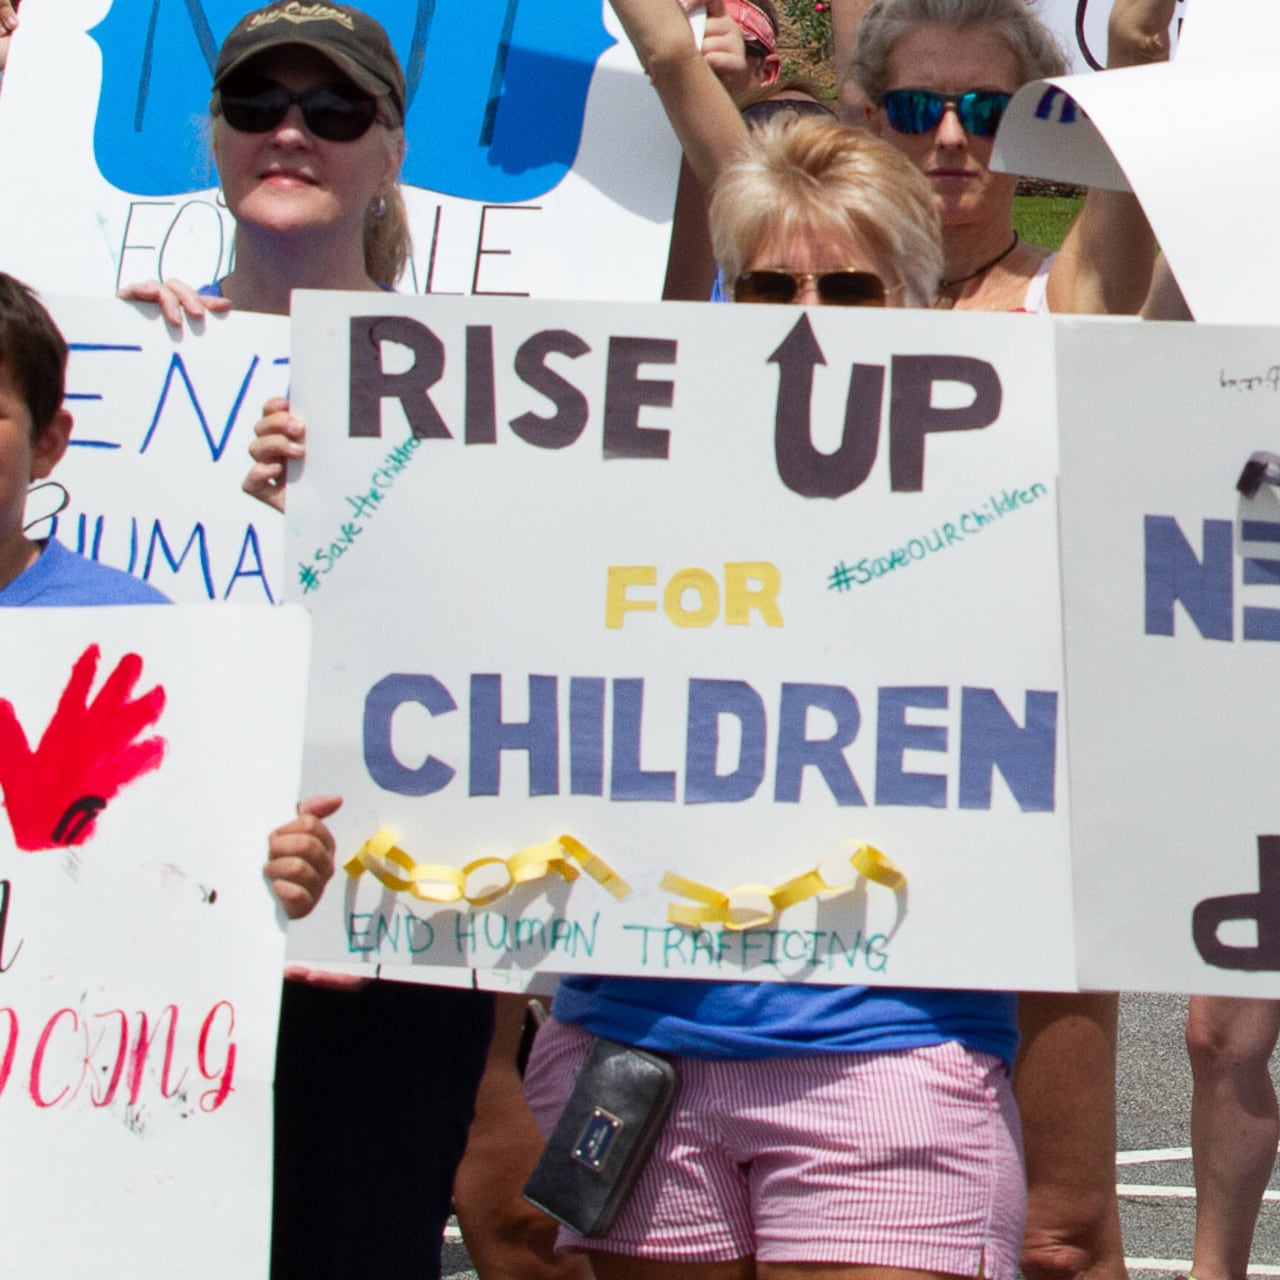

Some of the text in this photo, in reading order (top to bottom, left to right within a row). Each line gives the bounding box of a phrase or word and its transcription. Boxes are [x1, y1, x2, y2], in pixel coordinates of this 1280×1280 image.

[116, 200, 236, 294] FO
[347, 311, 1003, 499] RISE UP
[604, 561, 784, 629] FOR
[363, 672, 1059, 813] CHILDREN
[346, 912, 434, 955] END
[454, 910, 601, 958] HUMAN
